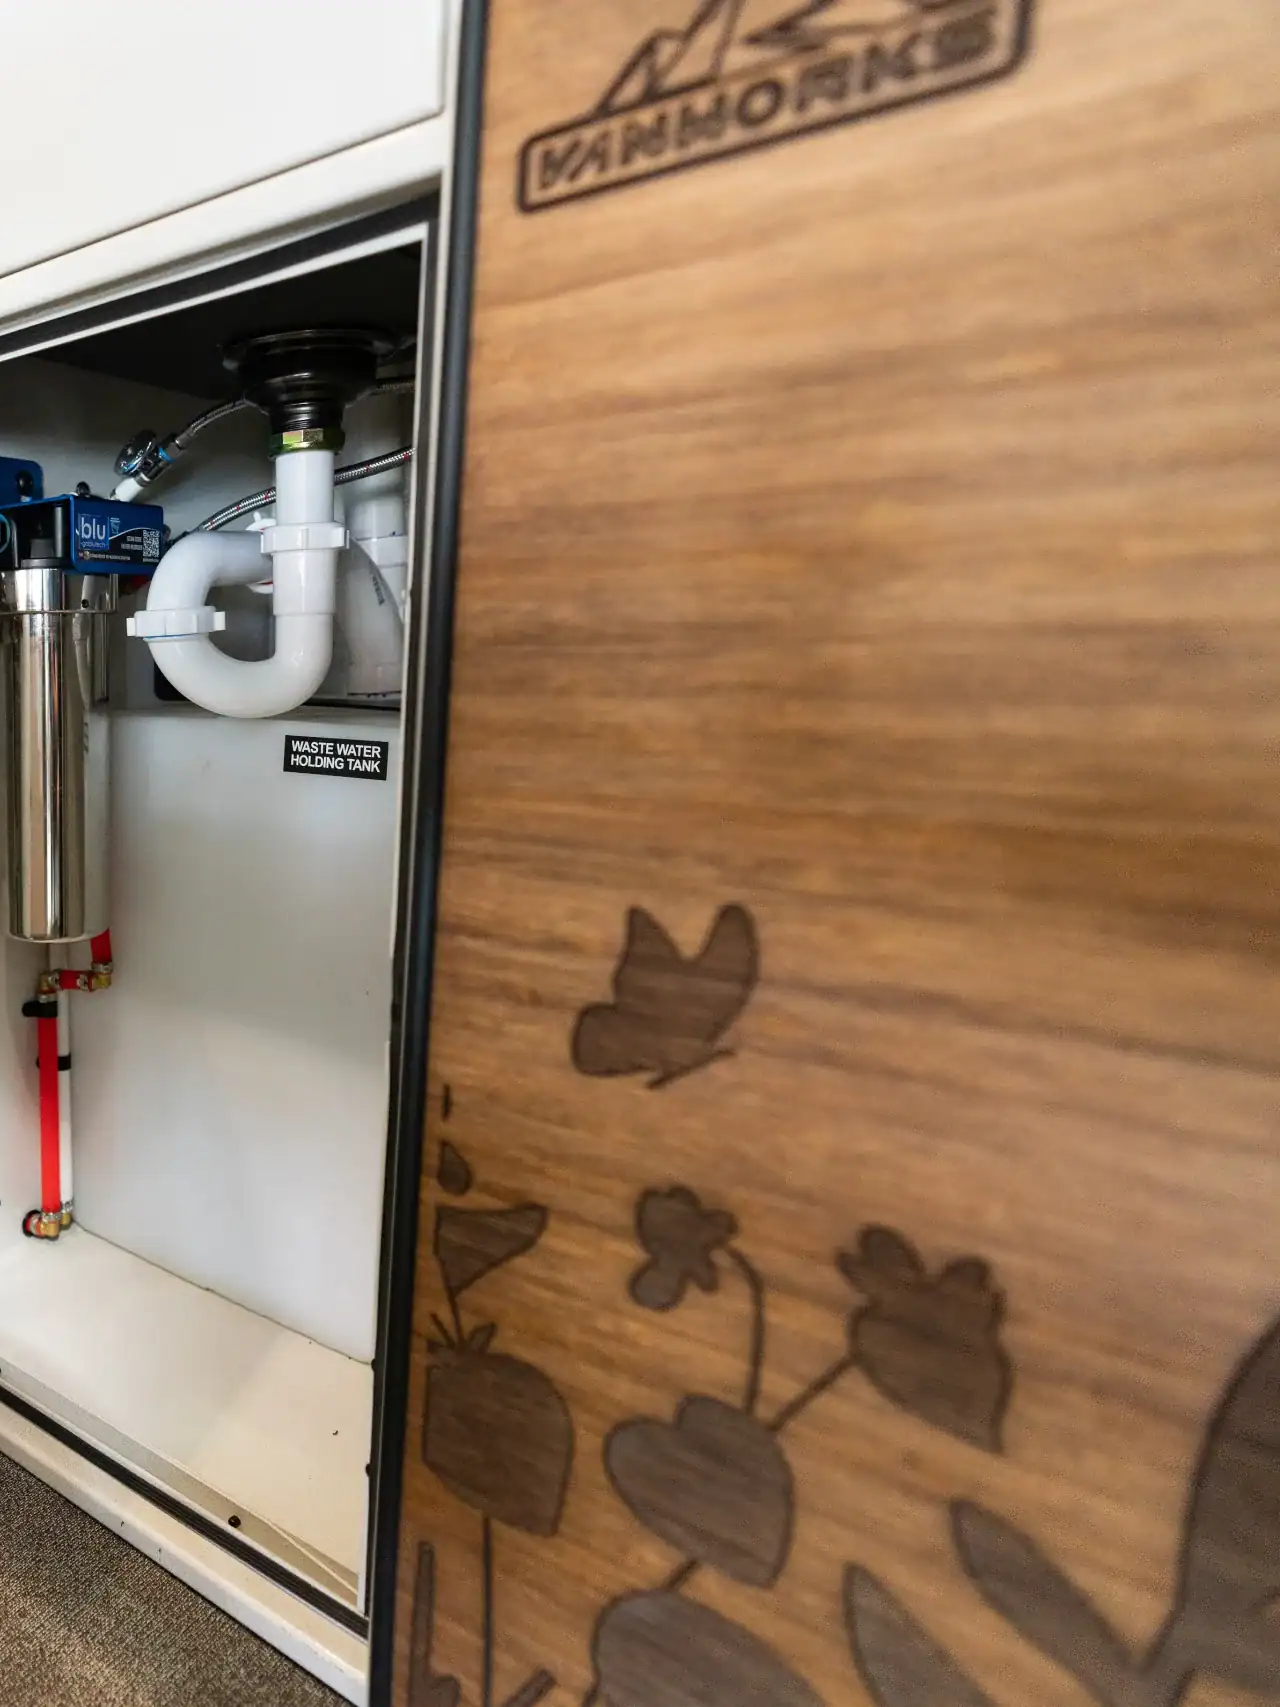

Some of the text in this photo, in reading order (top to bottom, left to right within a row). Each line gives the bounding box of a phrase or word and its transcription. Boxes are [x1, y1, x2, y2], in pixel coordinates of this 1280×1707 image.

[81, 517, 106, 540] blu
[291, 740, 381, 759] WASTE WATER
[290, 754, 381, 773] HOLDING TANK
